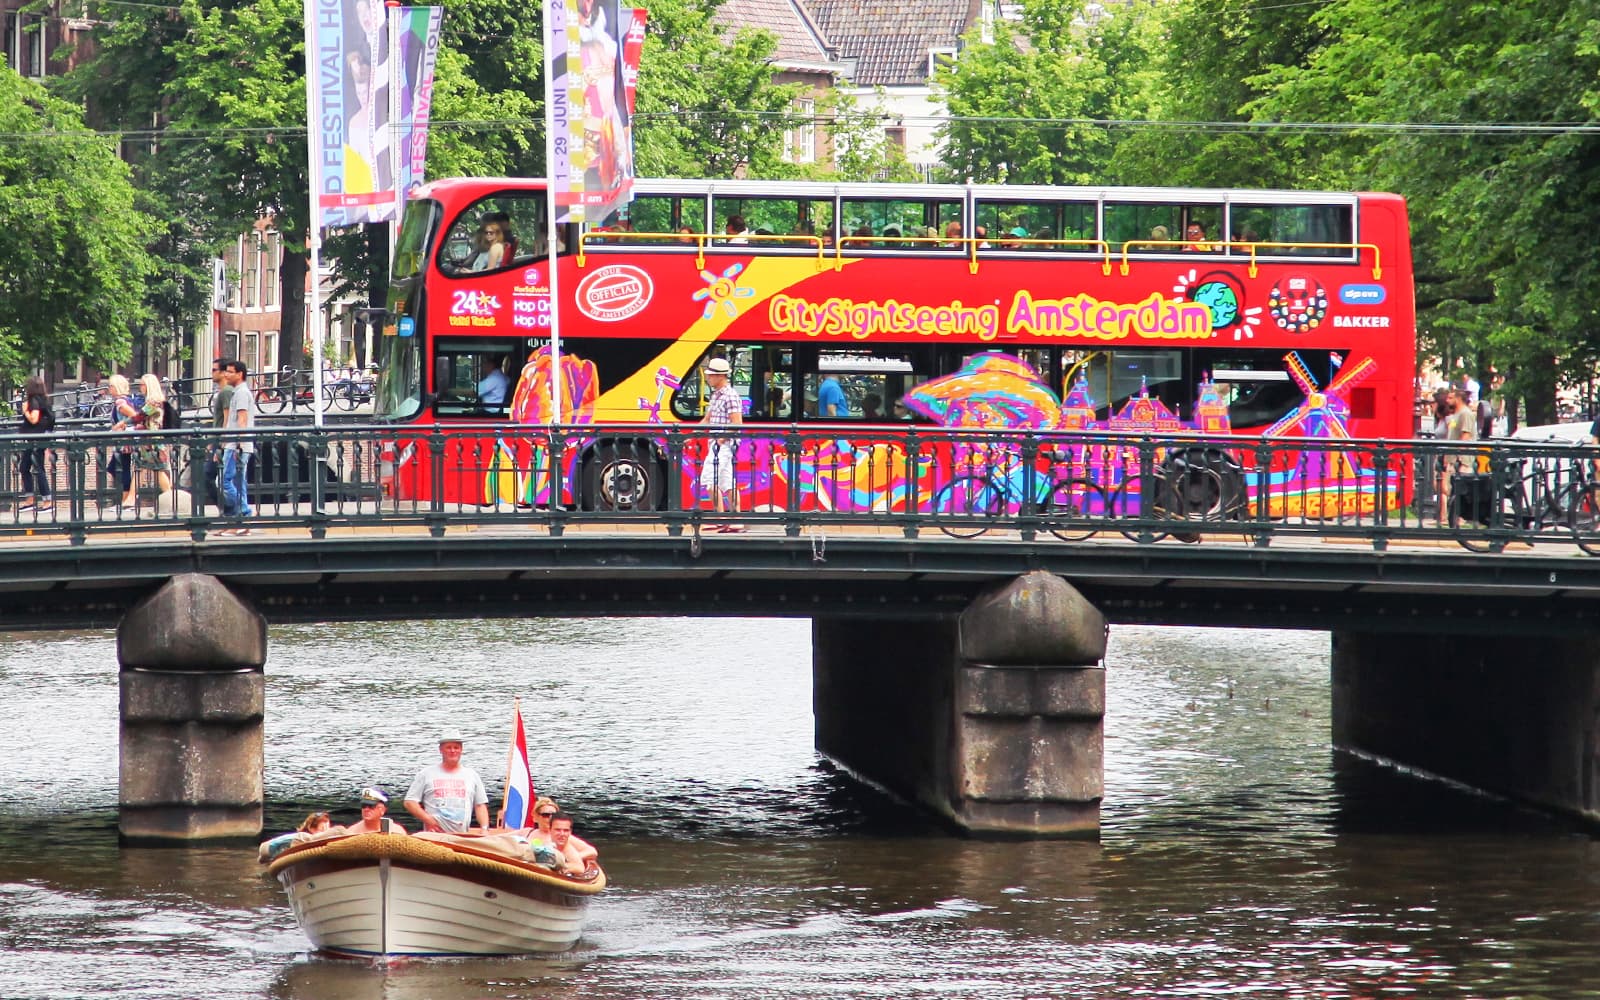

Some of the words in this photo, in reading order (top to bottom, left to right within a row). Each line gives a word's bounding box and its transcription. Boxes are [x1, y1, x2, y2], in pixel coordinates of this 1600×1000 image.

[627, 17, 646, 43] HF
[321, 36, 343, 167] FESTIVAL
[553, 88, 568, 127] JUNI
[411, 72, 434, 174] FESTIVAL
[554, 137, 568, 155] 29
[452, 290, 479, 314] 24
[591, 283, 638, 301] OFFICIAL
[514, 300, 535, 312] Hop
[1007, 290, 1212, 339] Amsterdam
[514, 315, 535, 327] Hop
[1333, 315, 1390, 328] BAKKER
